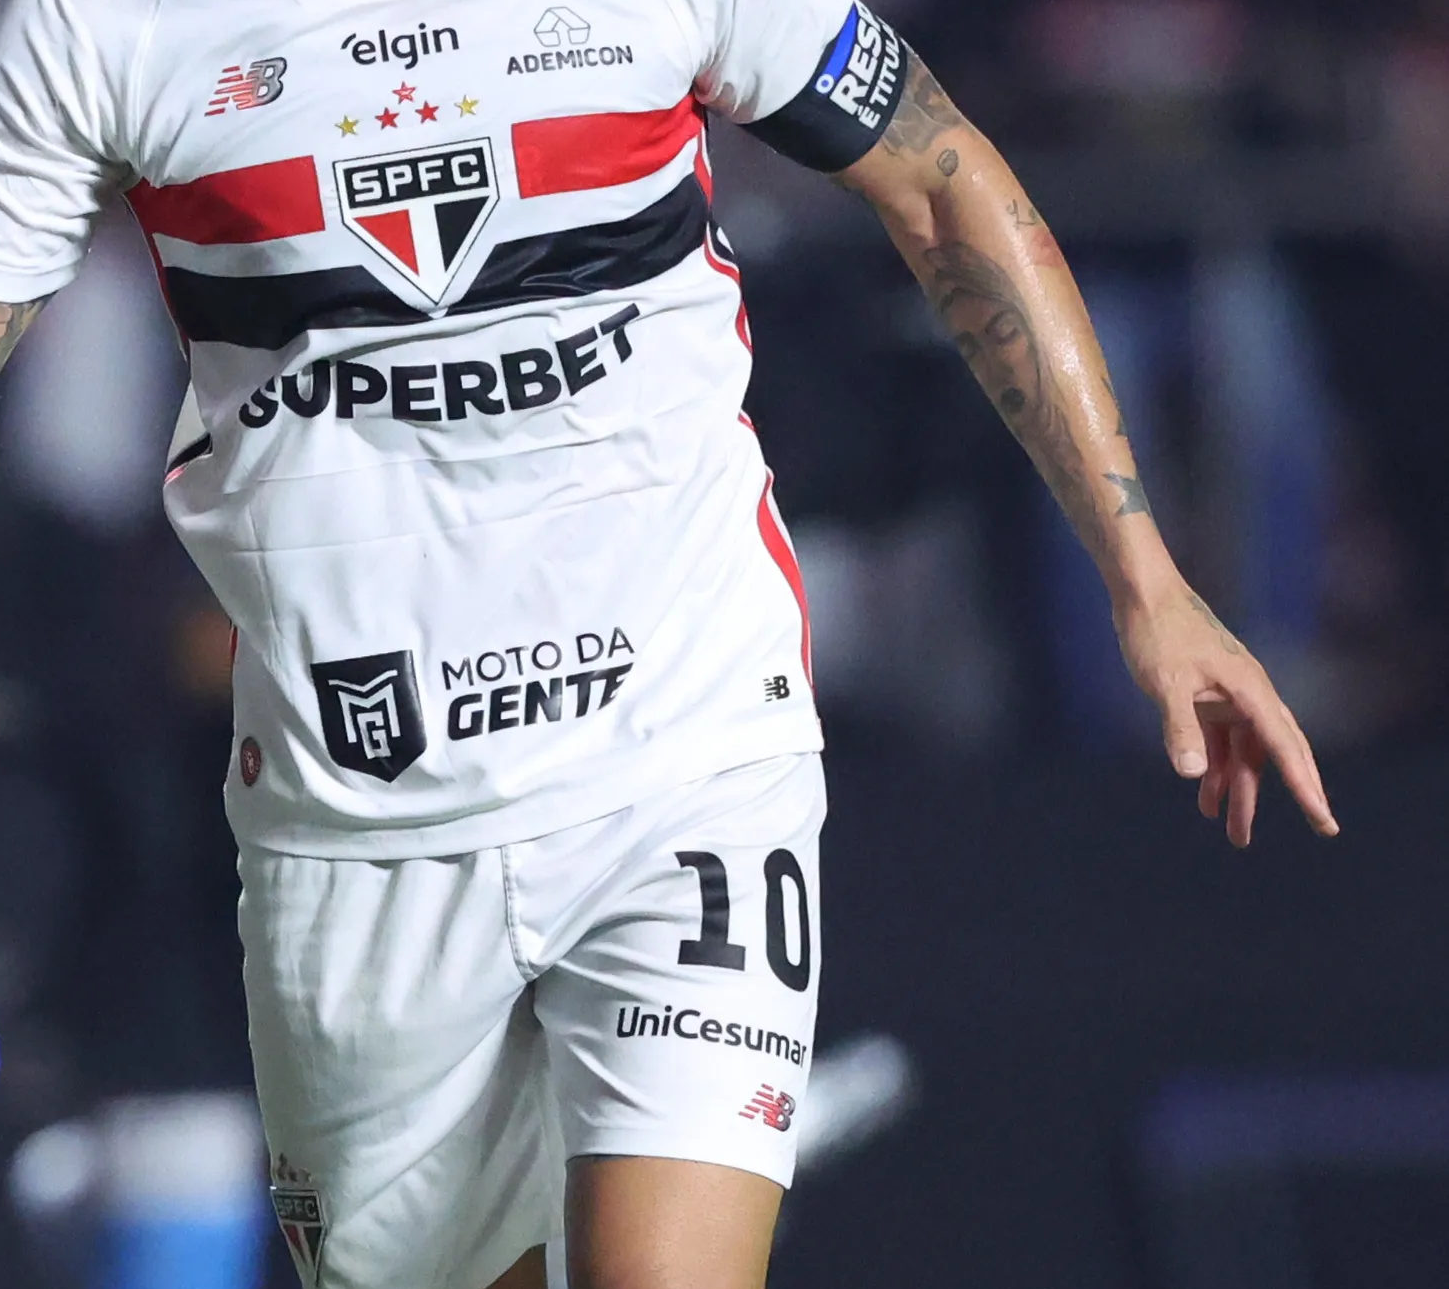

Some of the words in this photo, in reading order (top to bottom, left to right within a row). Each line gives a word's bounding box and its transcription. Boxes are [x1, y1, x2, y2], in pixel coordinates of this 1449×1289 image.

[506, 45, 634, 75] ADEMICON
[351, 153, 482, 203] SPFC
[238, 302, 641, 429] SUPERBET
[440, 639, 563, 691] MOTO
[575, 626, 635, 664] DA
[674, 847, 811, 993] 10
